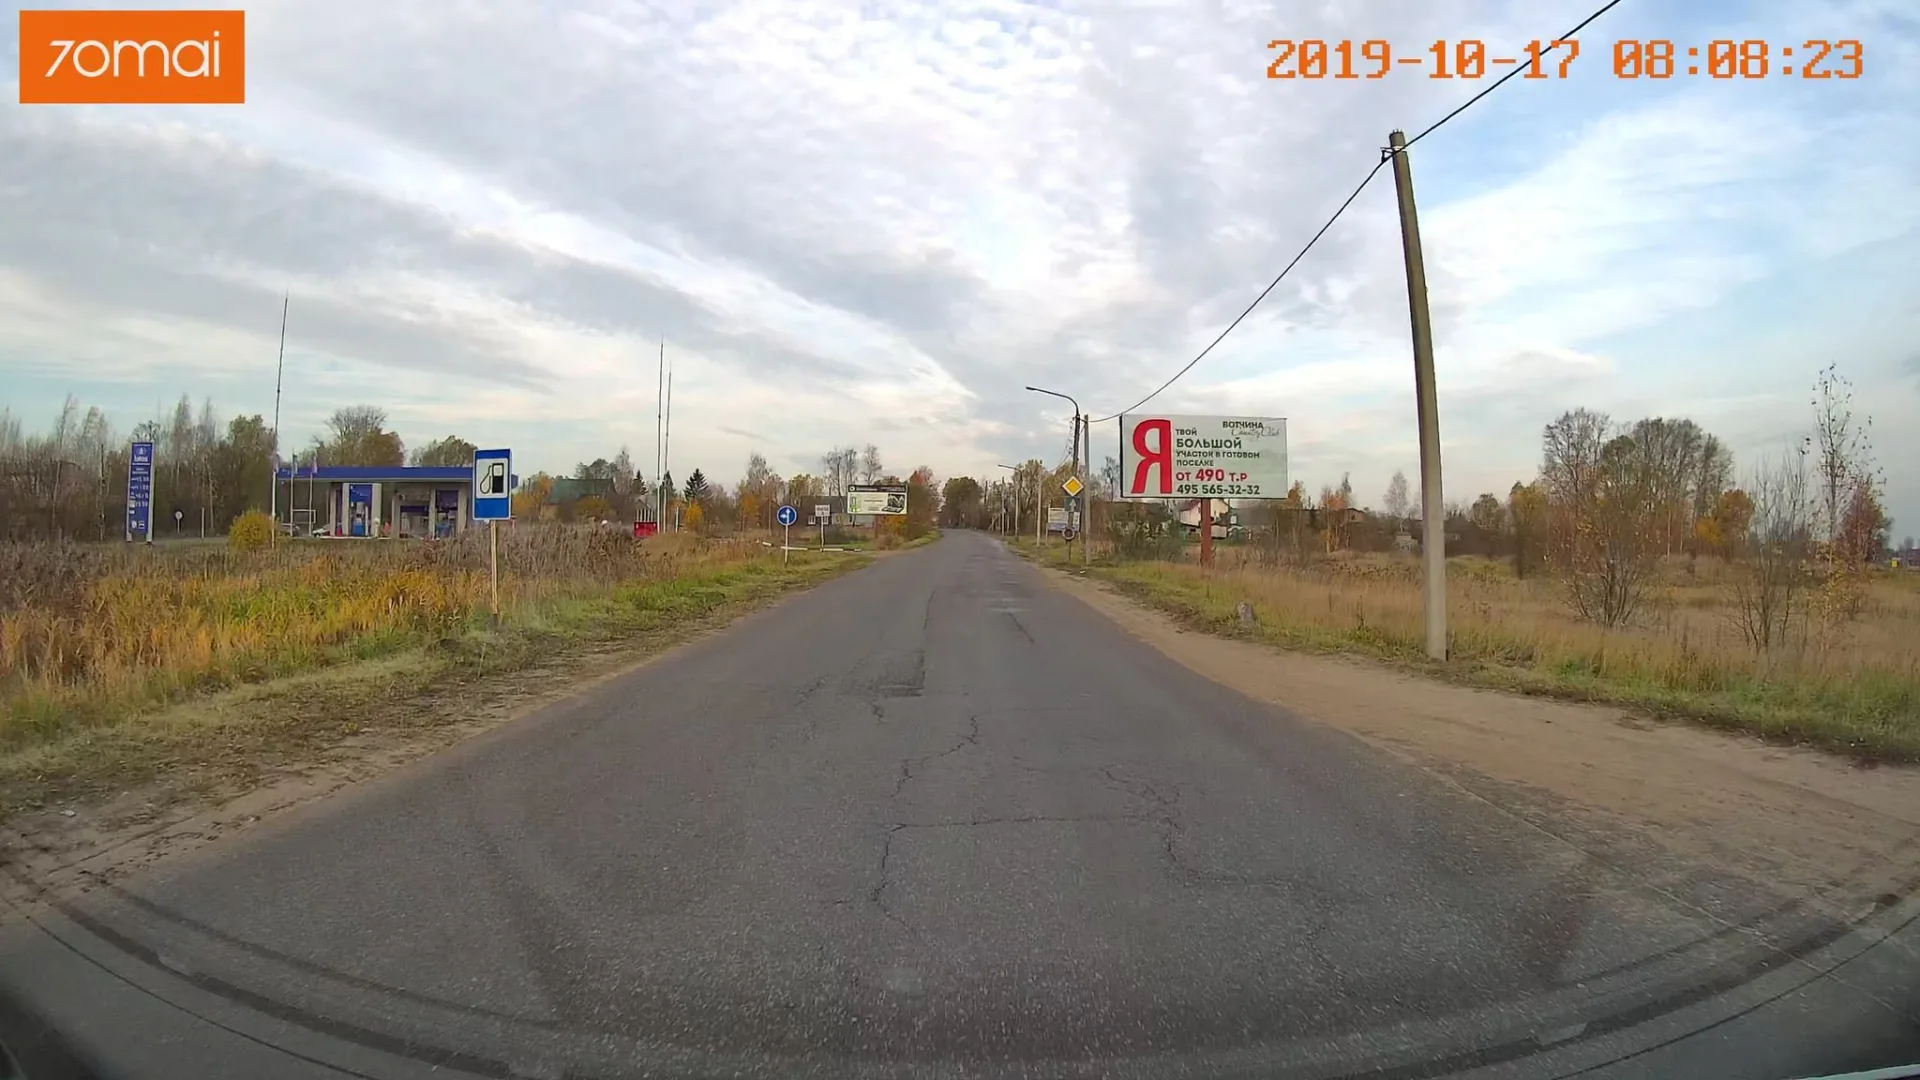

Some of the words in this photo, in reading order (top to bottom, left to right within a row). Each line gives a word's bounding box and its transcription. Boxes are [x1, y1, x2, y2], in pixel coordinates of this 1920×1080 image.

[1222, 421, 1264, 429] ВОТЧИНА
[1175, 428, 1197, 436] ТВОЙ
[1176, 437, 1242, 449] БОЛЬШОЙ
[1131, 419, 1172, 494] Я
[1222, 451, 1260, 459] ГОТОВОМ
[1176, 459, 1214, 467] ПОСЕЛКЕ
[1176, 472, 1191, 481] ОТ
[1195, 469, 1224, 482] 490
[1176, 484, 1198, 495] 495
[1202, 485, 1260, 495] 565-32-32
